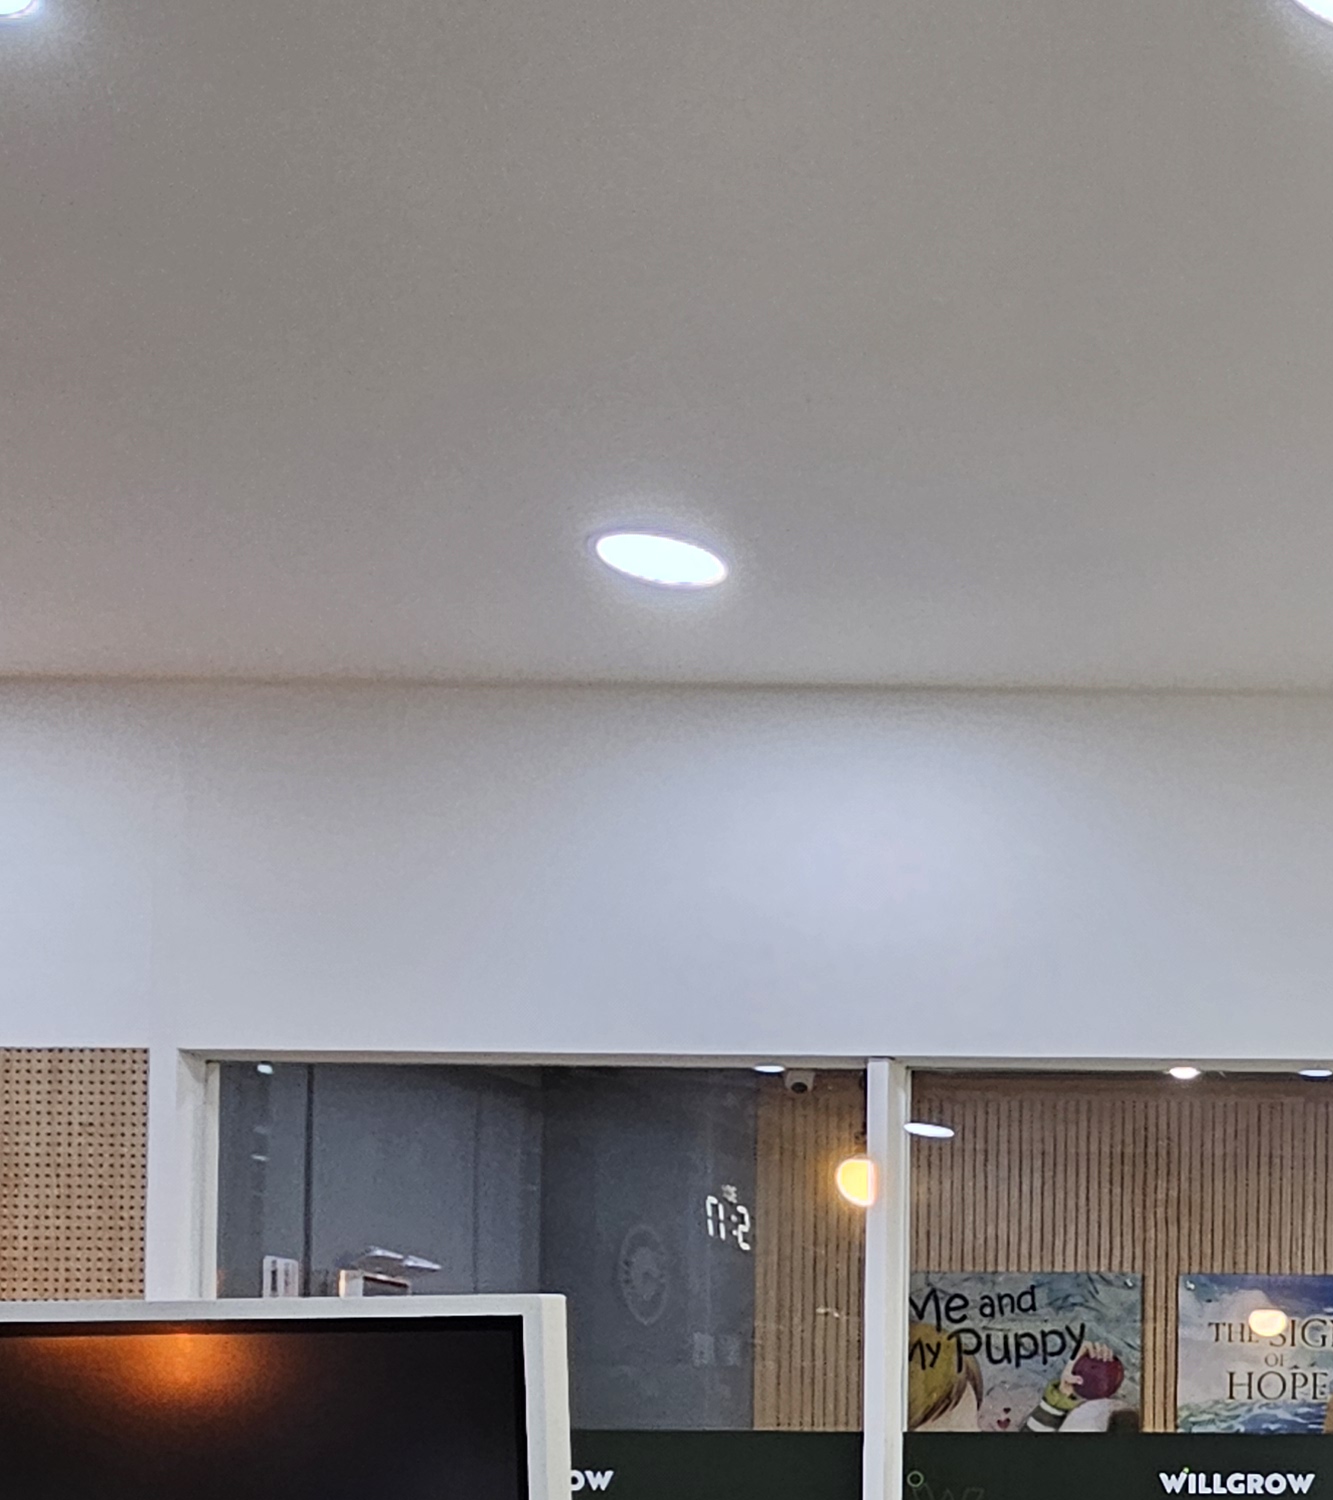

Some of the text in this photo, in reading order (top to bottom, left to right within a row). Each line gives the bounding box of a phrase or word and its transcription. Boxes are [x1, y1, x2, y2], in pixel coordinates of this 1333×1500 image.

[979, 1284, 1037, 1318] and
[947, 1322, 1086, 1374] Puppy
[1226, 1370, 1329, 1401] HOPE
[1159, 1466, 1316, 1495] WILLGROW
